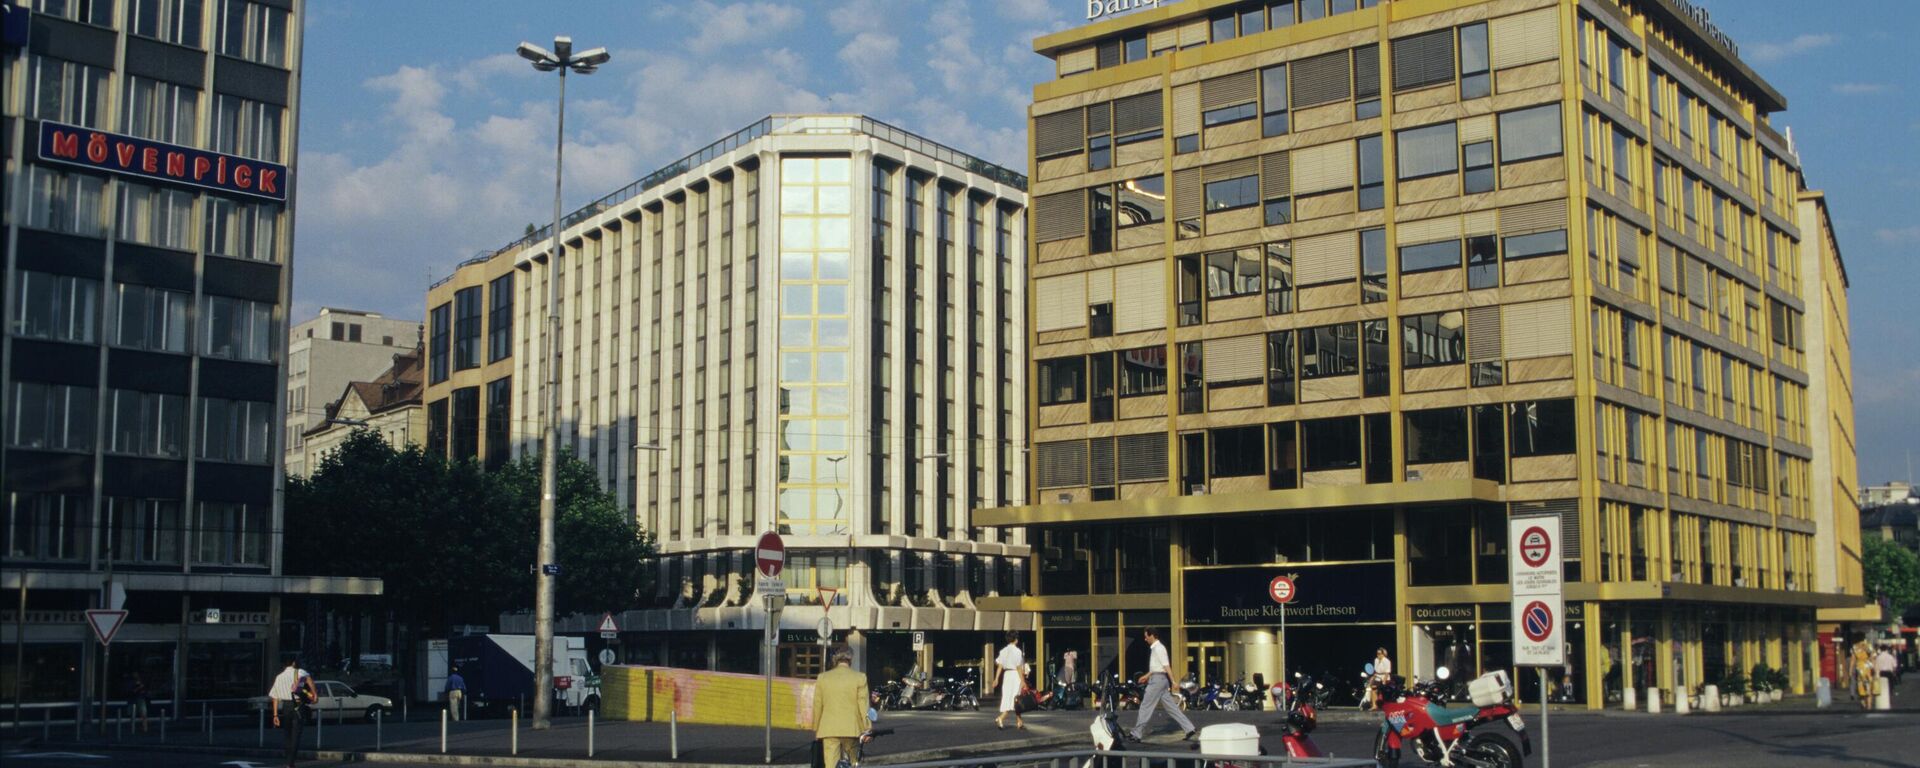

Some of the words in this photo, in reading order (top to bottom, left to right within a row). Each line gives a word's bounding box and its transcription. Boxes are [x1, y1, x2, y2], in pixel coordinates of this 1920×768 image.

[207, 611, 219, 620] 40
[1220, 606, 1259, 620] Banque
[1316, 604, 1356, 616] Benson
[1416, 608, 1472, 618] COLLECTIONS
